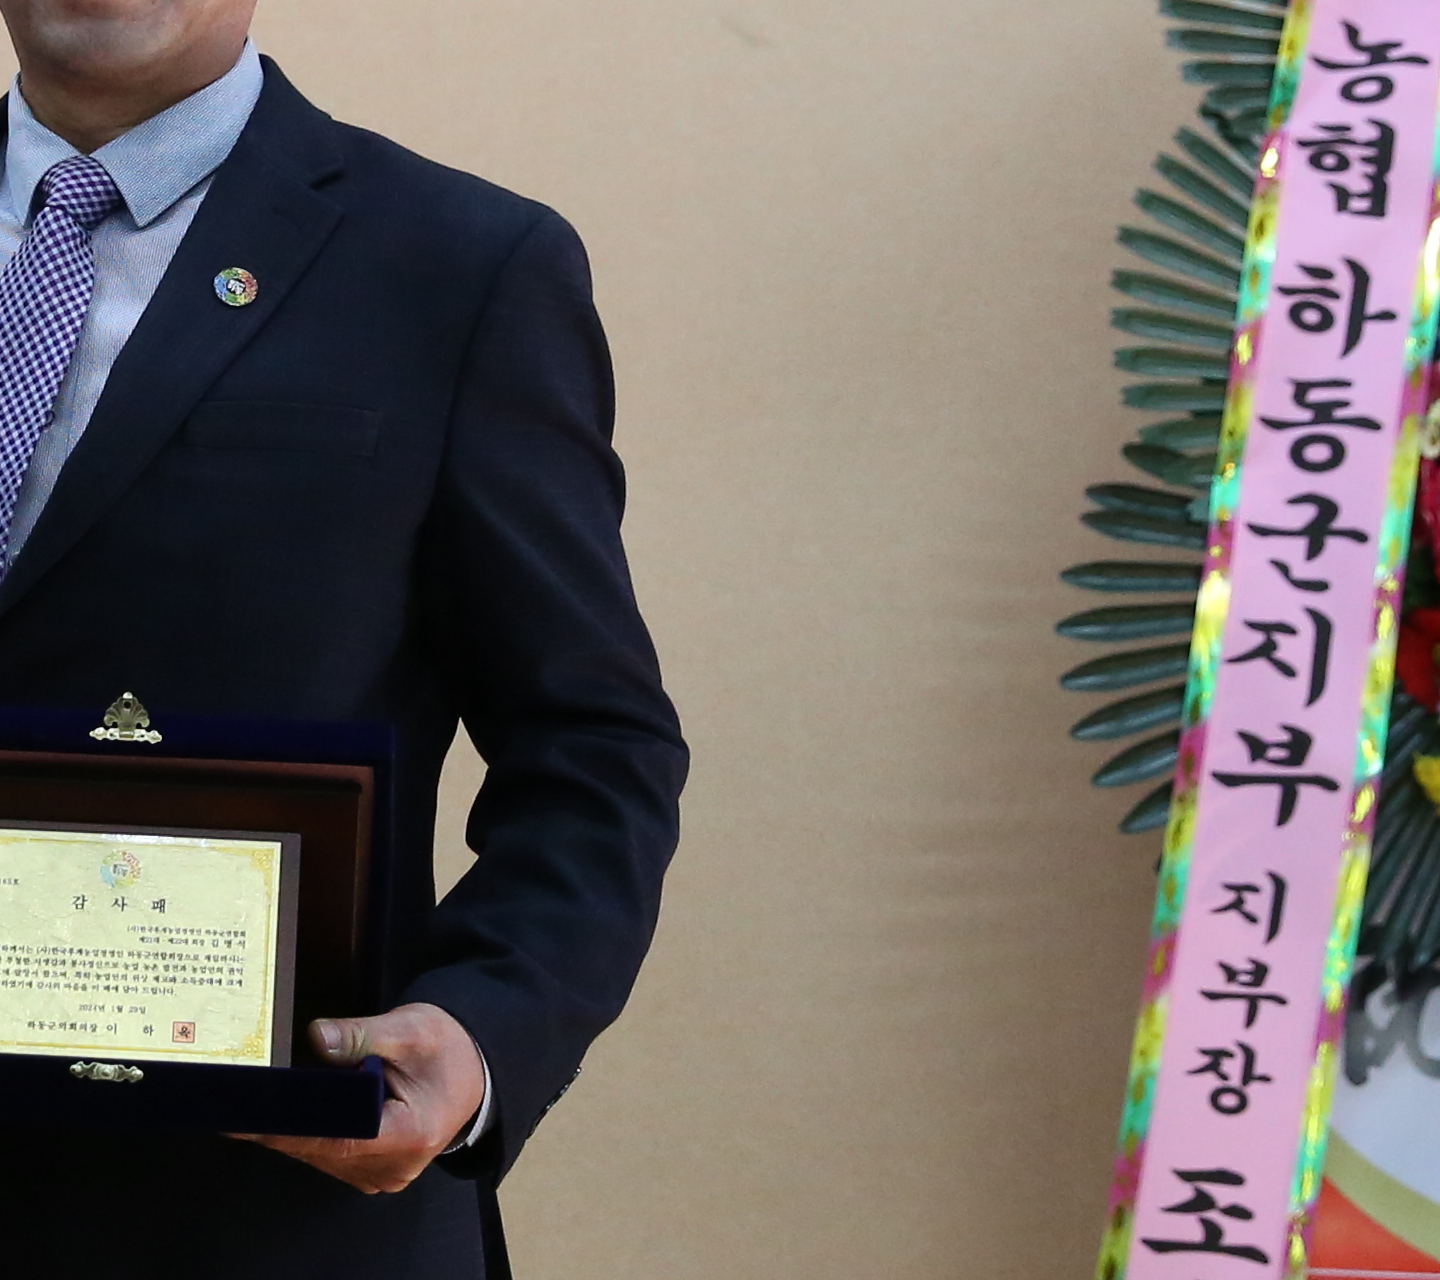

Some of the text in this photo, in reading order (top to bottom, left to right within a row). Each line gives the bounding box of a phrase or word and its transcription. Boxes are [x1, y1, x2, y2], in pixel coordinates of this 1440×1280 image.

[1296, 21, 1430, 217] 농협
[1211, 256, 1398, 826] 하동군지부
[1185, 870, 1290, 1117] 지부장
